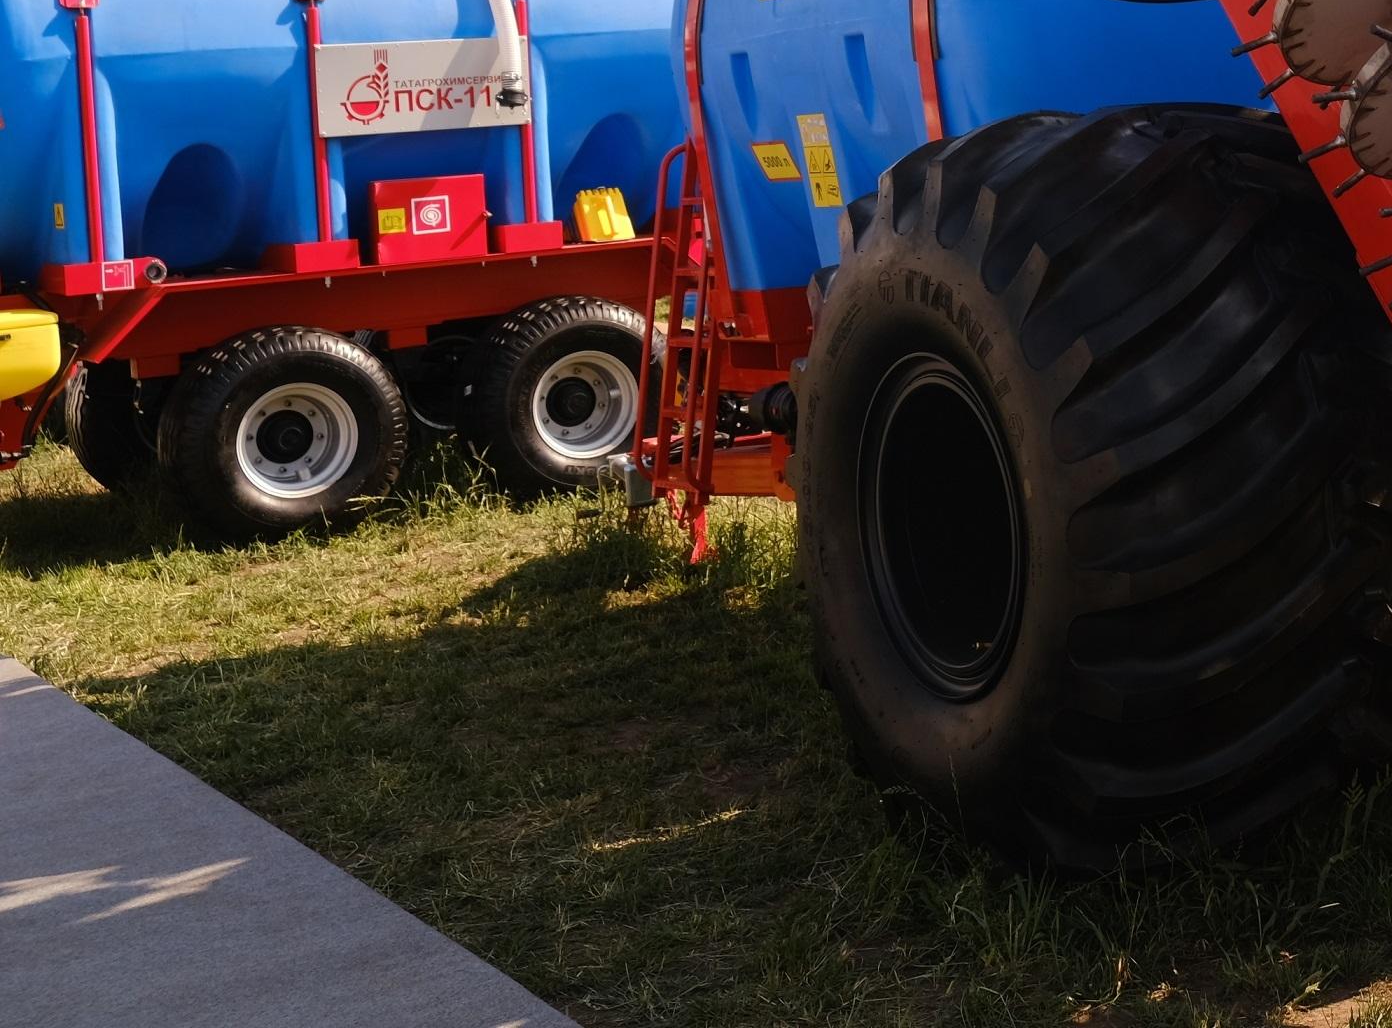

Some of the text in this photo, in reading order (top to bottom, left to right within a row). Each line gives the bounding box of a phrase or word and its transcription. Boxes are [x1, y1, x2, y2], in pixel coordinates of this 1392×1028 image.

[394, 75, 503, 89] ТАТАГРОХИМСЕРВИ
[394, 85, 492, 113] ПСК-11
[762, 155, 783, 168] 5000
